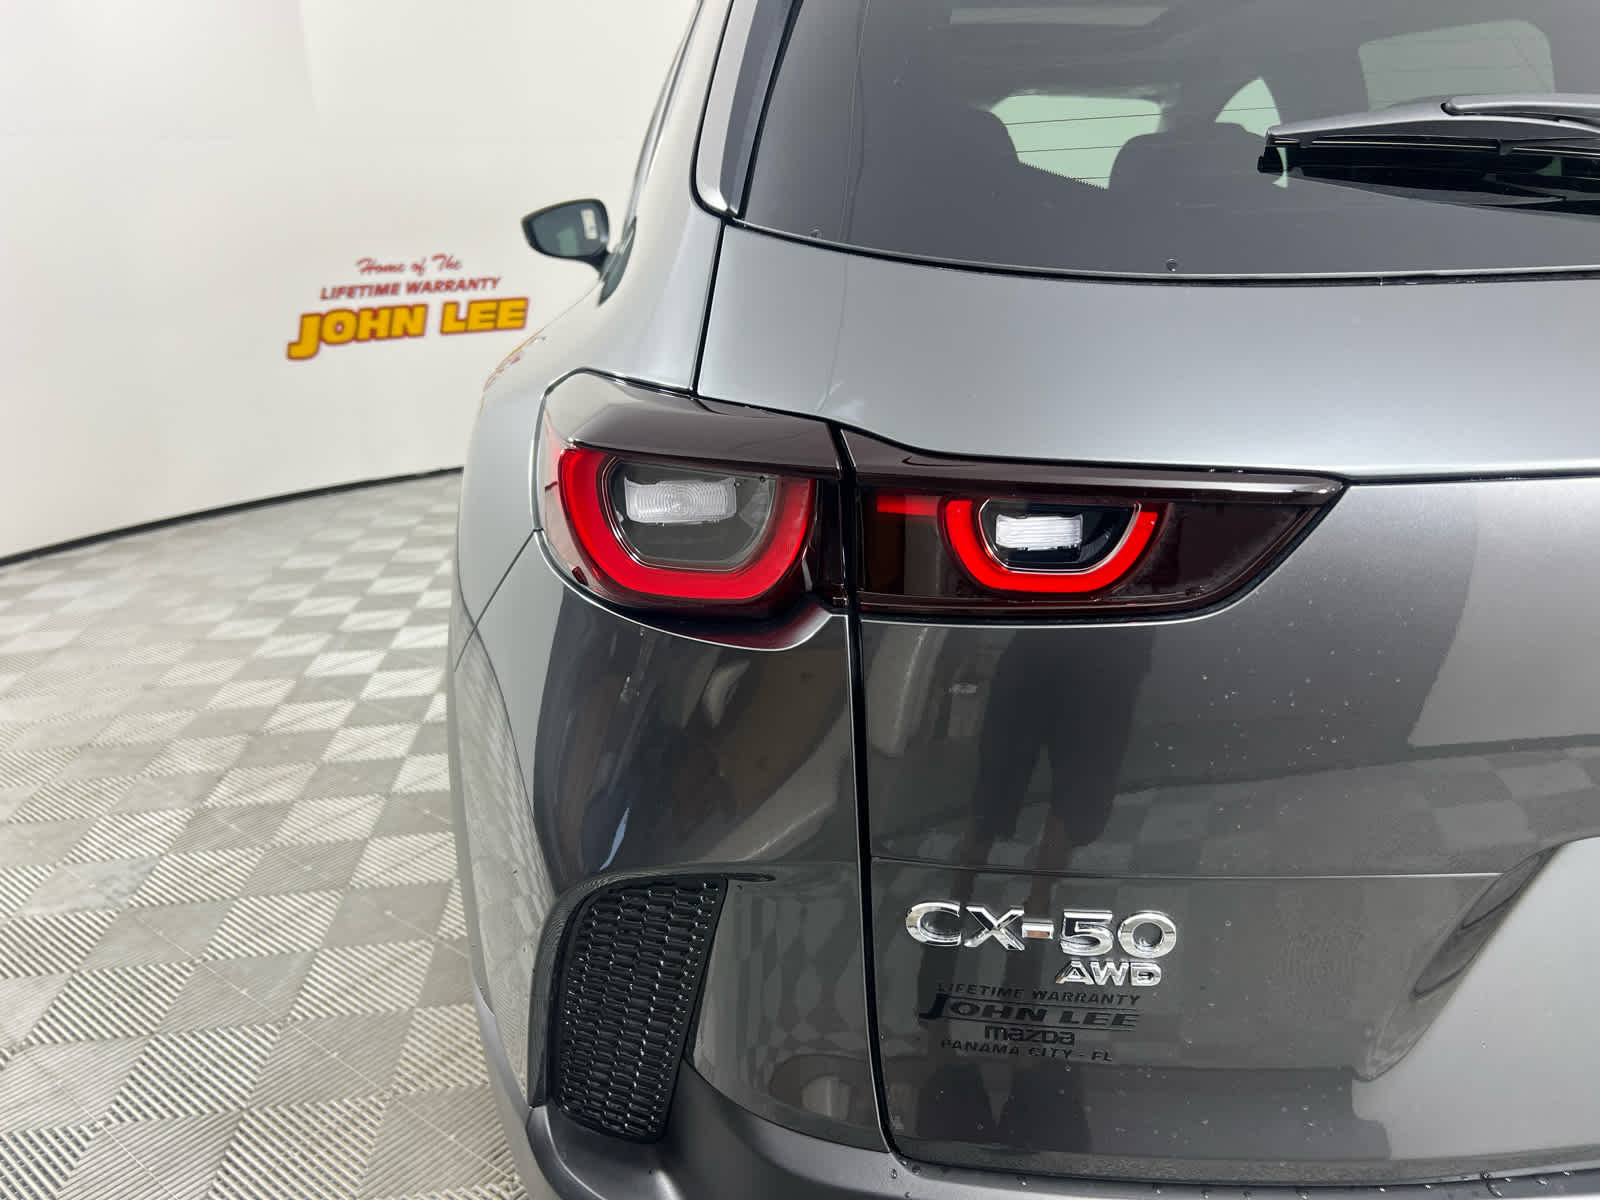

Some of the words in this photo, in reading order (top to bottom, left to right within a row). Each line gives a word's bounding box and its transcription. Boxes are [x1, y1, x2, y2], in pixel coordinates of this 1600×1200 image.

[356, 256, 406, 276] Home
[432, 253, 463, 272] The
[320, 280, 401, 301] LIFETIME
[406, 276, 501, 296] WARRANTY
[286, 303, 428, 361] JOHN
[440, 297, 529, 335] LEE
[905, 901, 1178, 959] CX-50
[1055, 959, 1163, 987] AWD
[935, 982, 1025, 1000] LIFETIME
[1031, 989, 1141, 1006] WARRANTY
[919, 992, 1048, 1023] JOHN
[1058, 1008, 1141, 1030] LEE
[984, 1025, 1076, 1046] mazda
[941, 1039, 1020, 1057] PANAMA
[1027, 1046, 1072, 1060] CITY
[1091, 1050, 1114, 1062] FL
